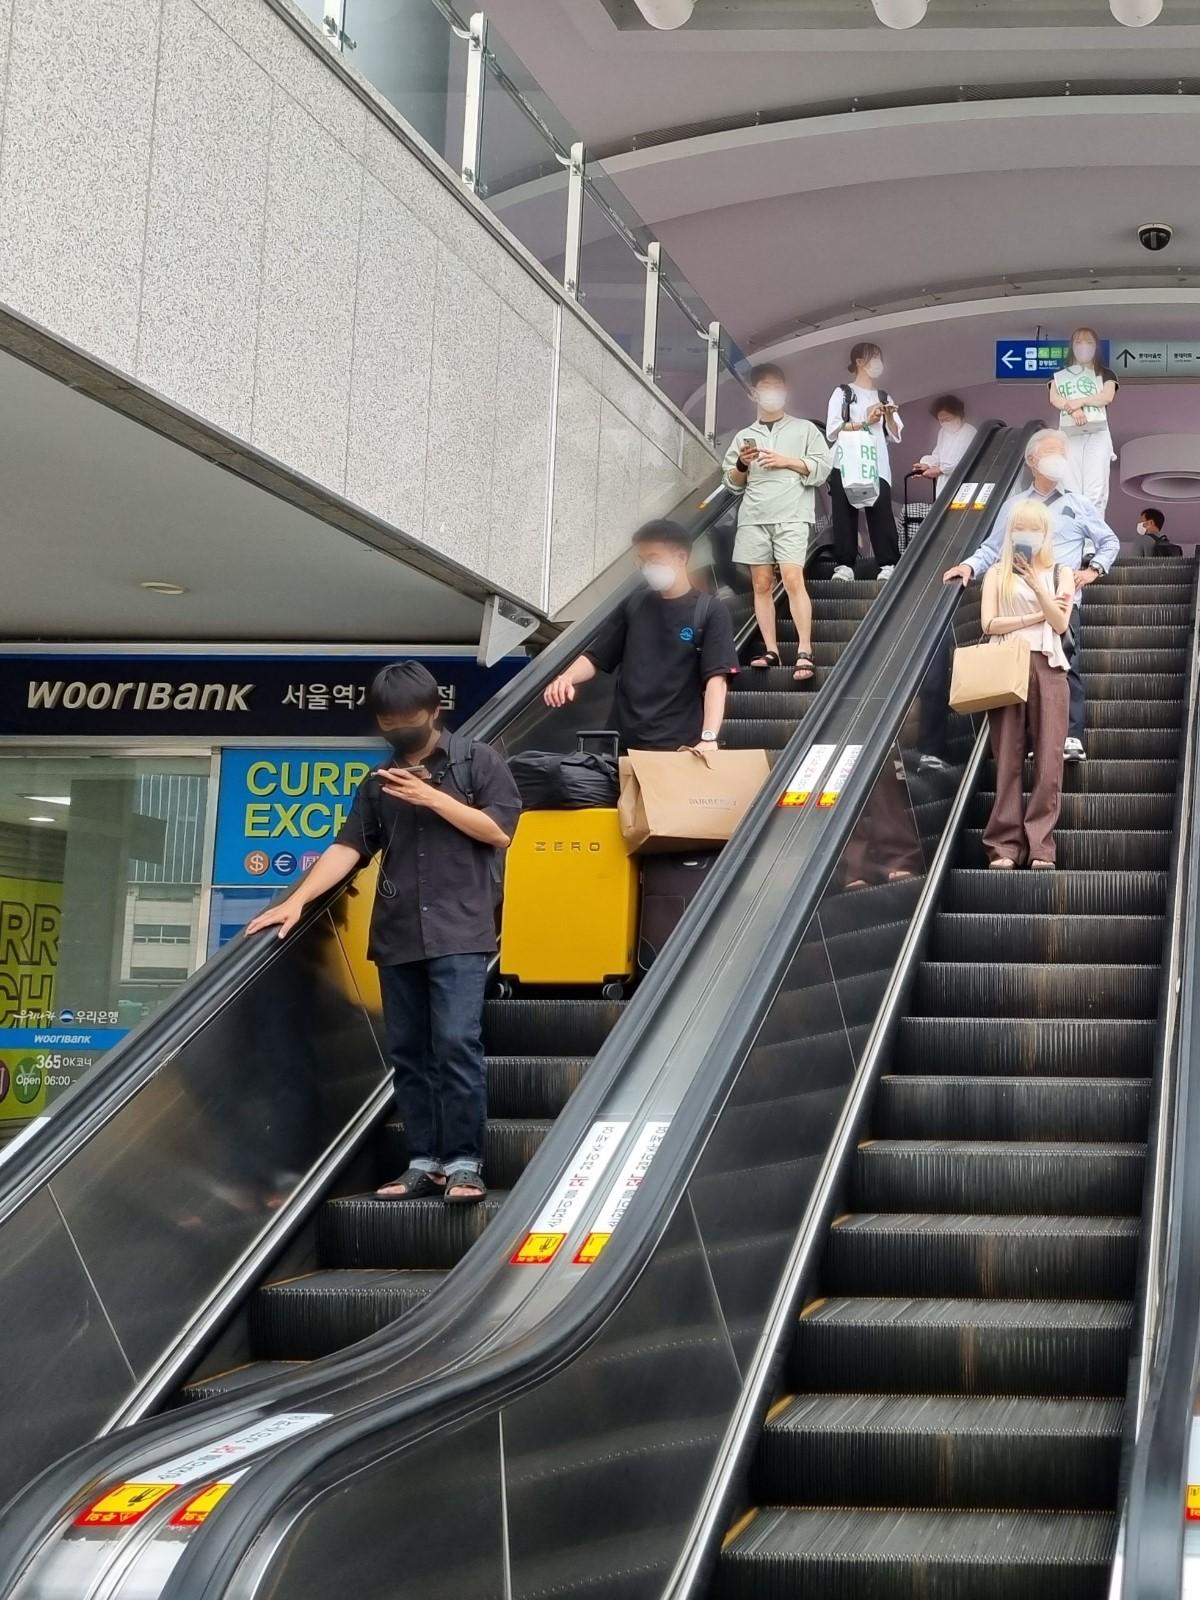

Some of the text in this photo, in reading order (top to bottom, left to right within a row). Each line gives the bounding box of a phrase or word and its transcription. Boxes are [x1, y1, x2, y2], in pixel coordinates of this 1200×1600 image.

[246, 761, 371, 796] CURR
[535, 841, 600, 852] ZERO
[75, 1010, 119, 1024] 우리은행
[36, 1054, 92, 1070] 365 OK코너
[16, 1075, 70, 1087] Open 06:00
[568, 1173, 590, 1186] 꼭
